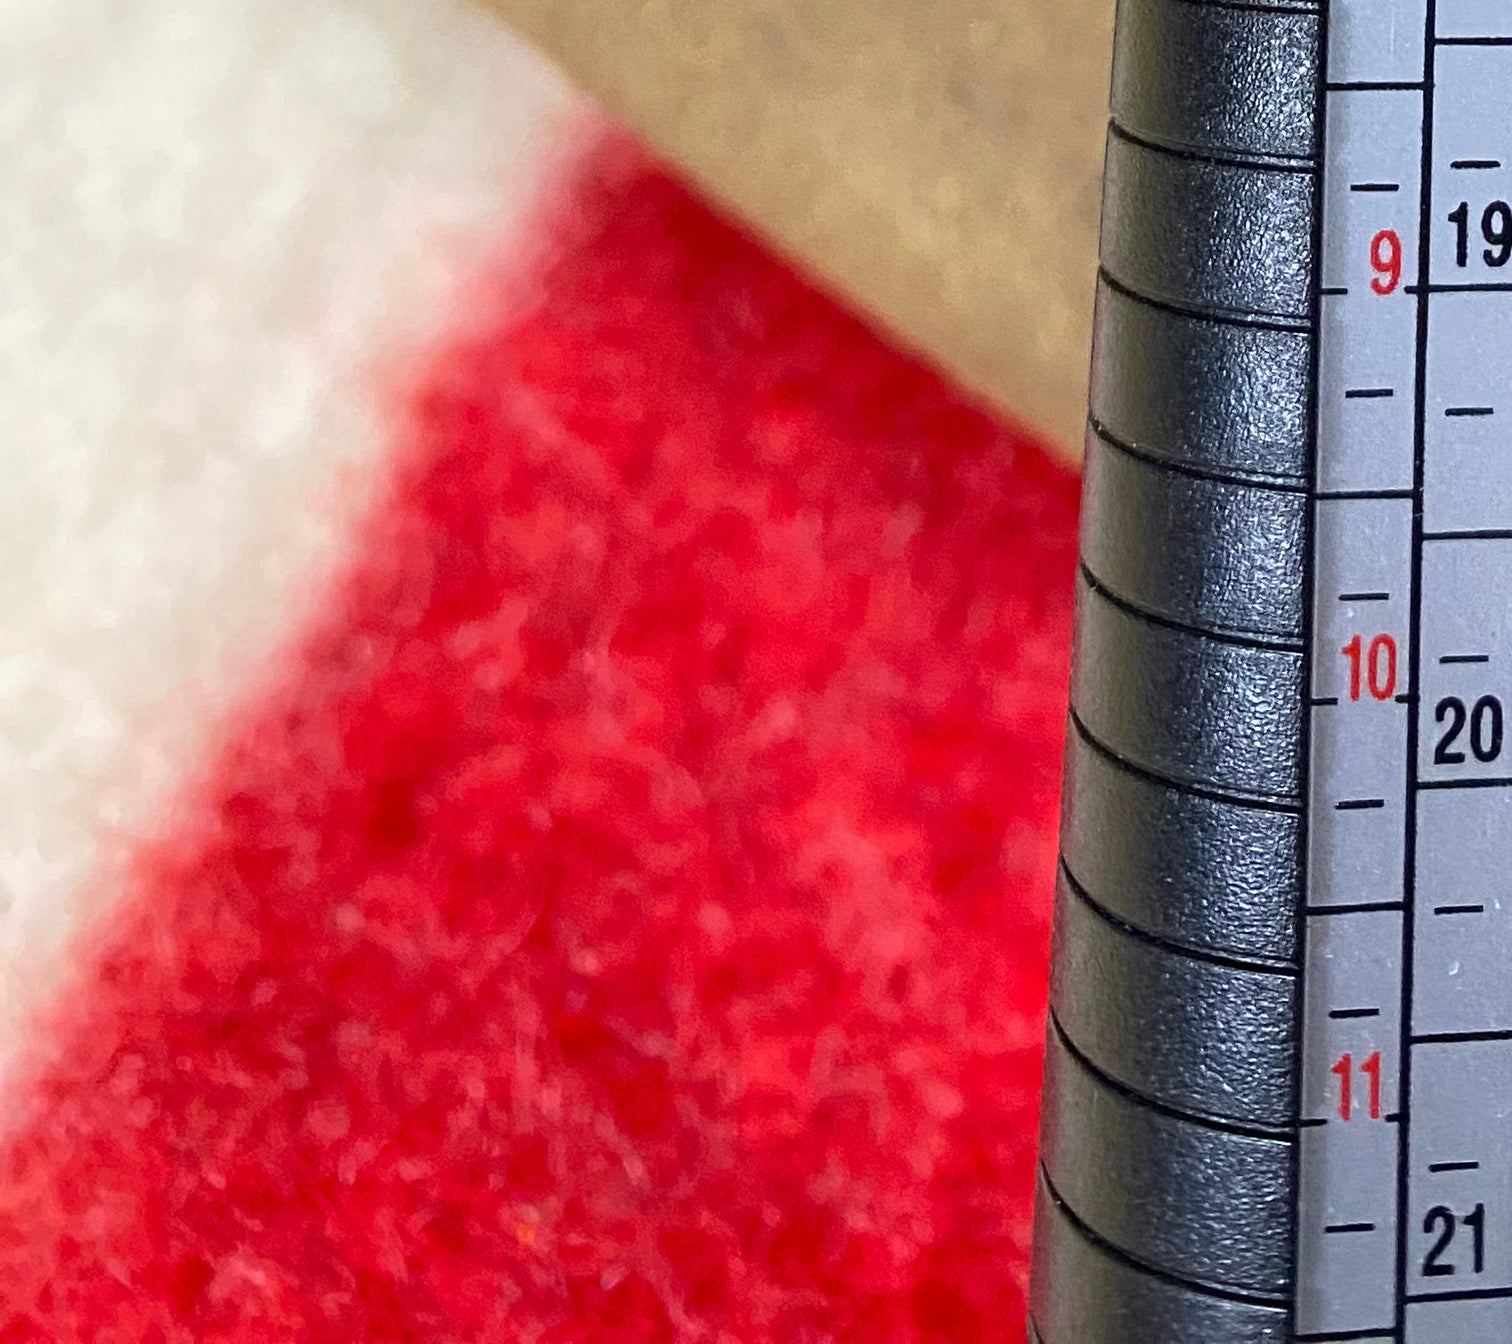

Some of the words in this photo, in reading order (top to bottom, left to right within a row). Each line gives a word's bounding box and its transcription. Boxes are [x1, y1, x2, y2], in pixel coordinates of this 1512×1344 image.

[1370, 230, 1402, 295] 9
[1342, 633, 1397, 702] 10
[1433, 696, 1504, 764] 20
[1330, 1052, 1381, 1122] 11
[1421, 1205, 1485, 1276] 21
